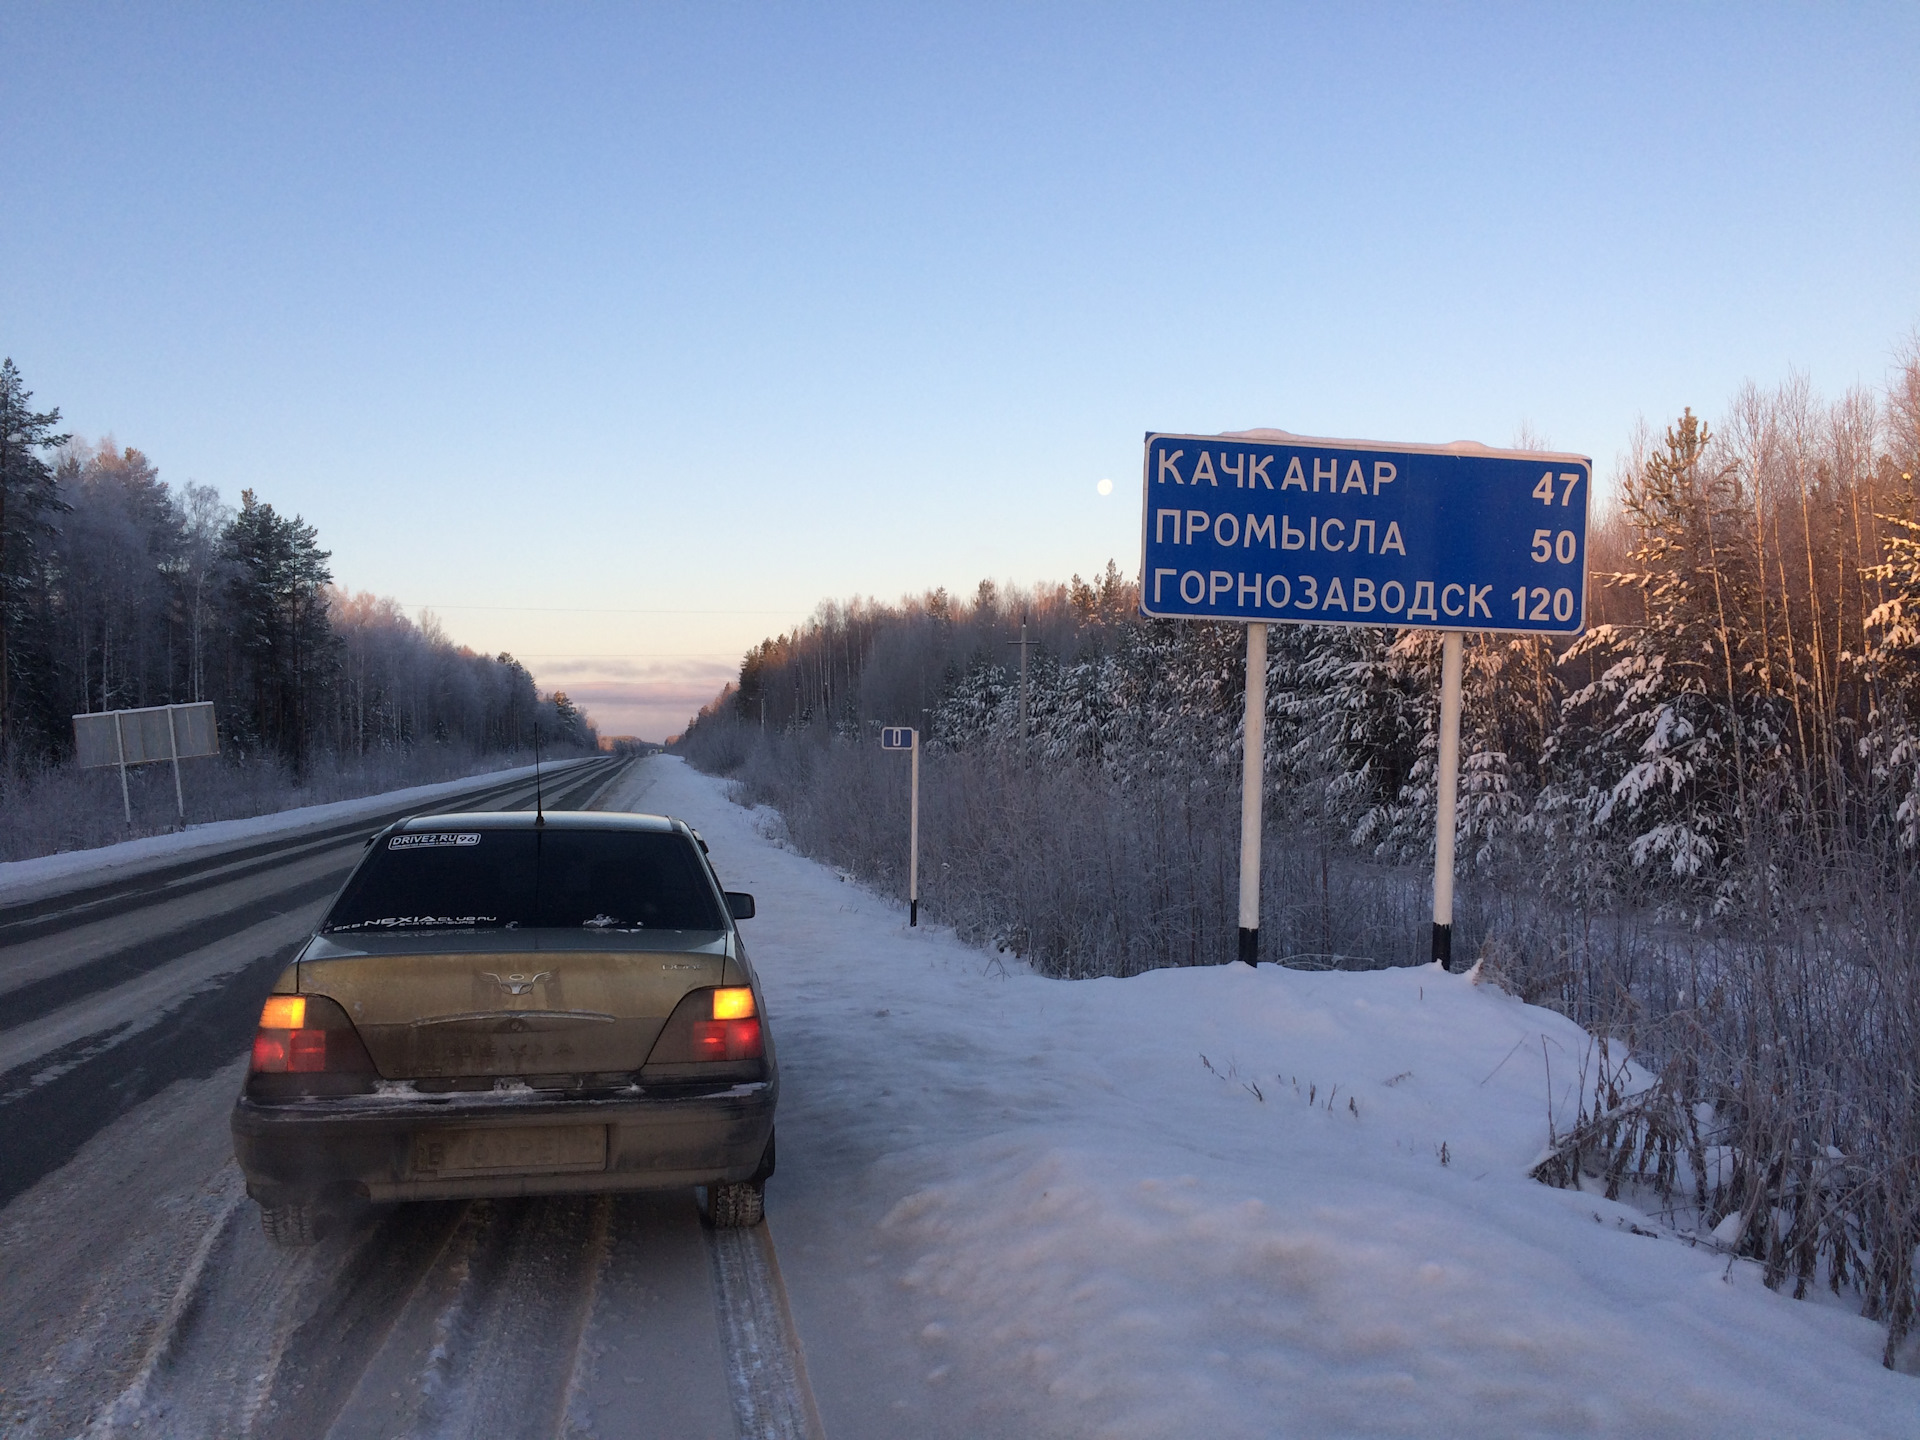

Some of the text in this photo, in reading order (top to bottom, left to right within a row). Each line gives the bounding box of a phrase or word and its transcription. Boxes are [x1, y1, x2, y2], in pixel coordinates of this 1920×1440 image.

[1157, 448, 1580, 506] КАЧКАНАР 47
[1155, 508, 1577, 564] ПРОМЫСЛА 50
[1154, 567, 1574, 622] ГОРНОЗАВОДСК 120
[392, 834, 457, 846] DRIVE2.RU
